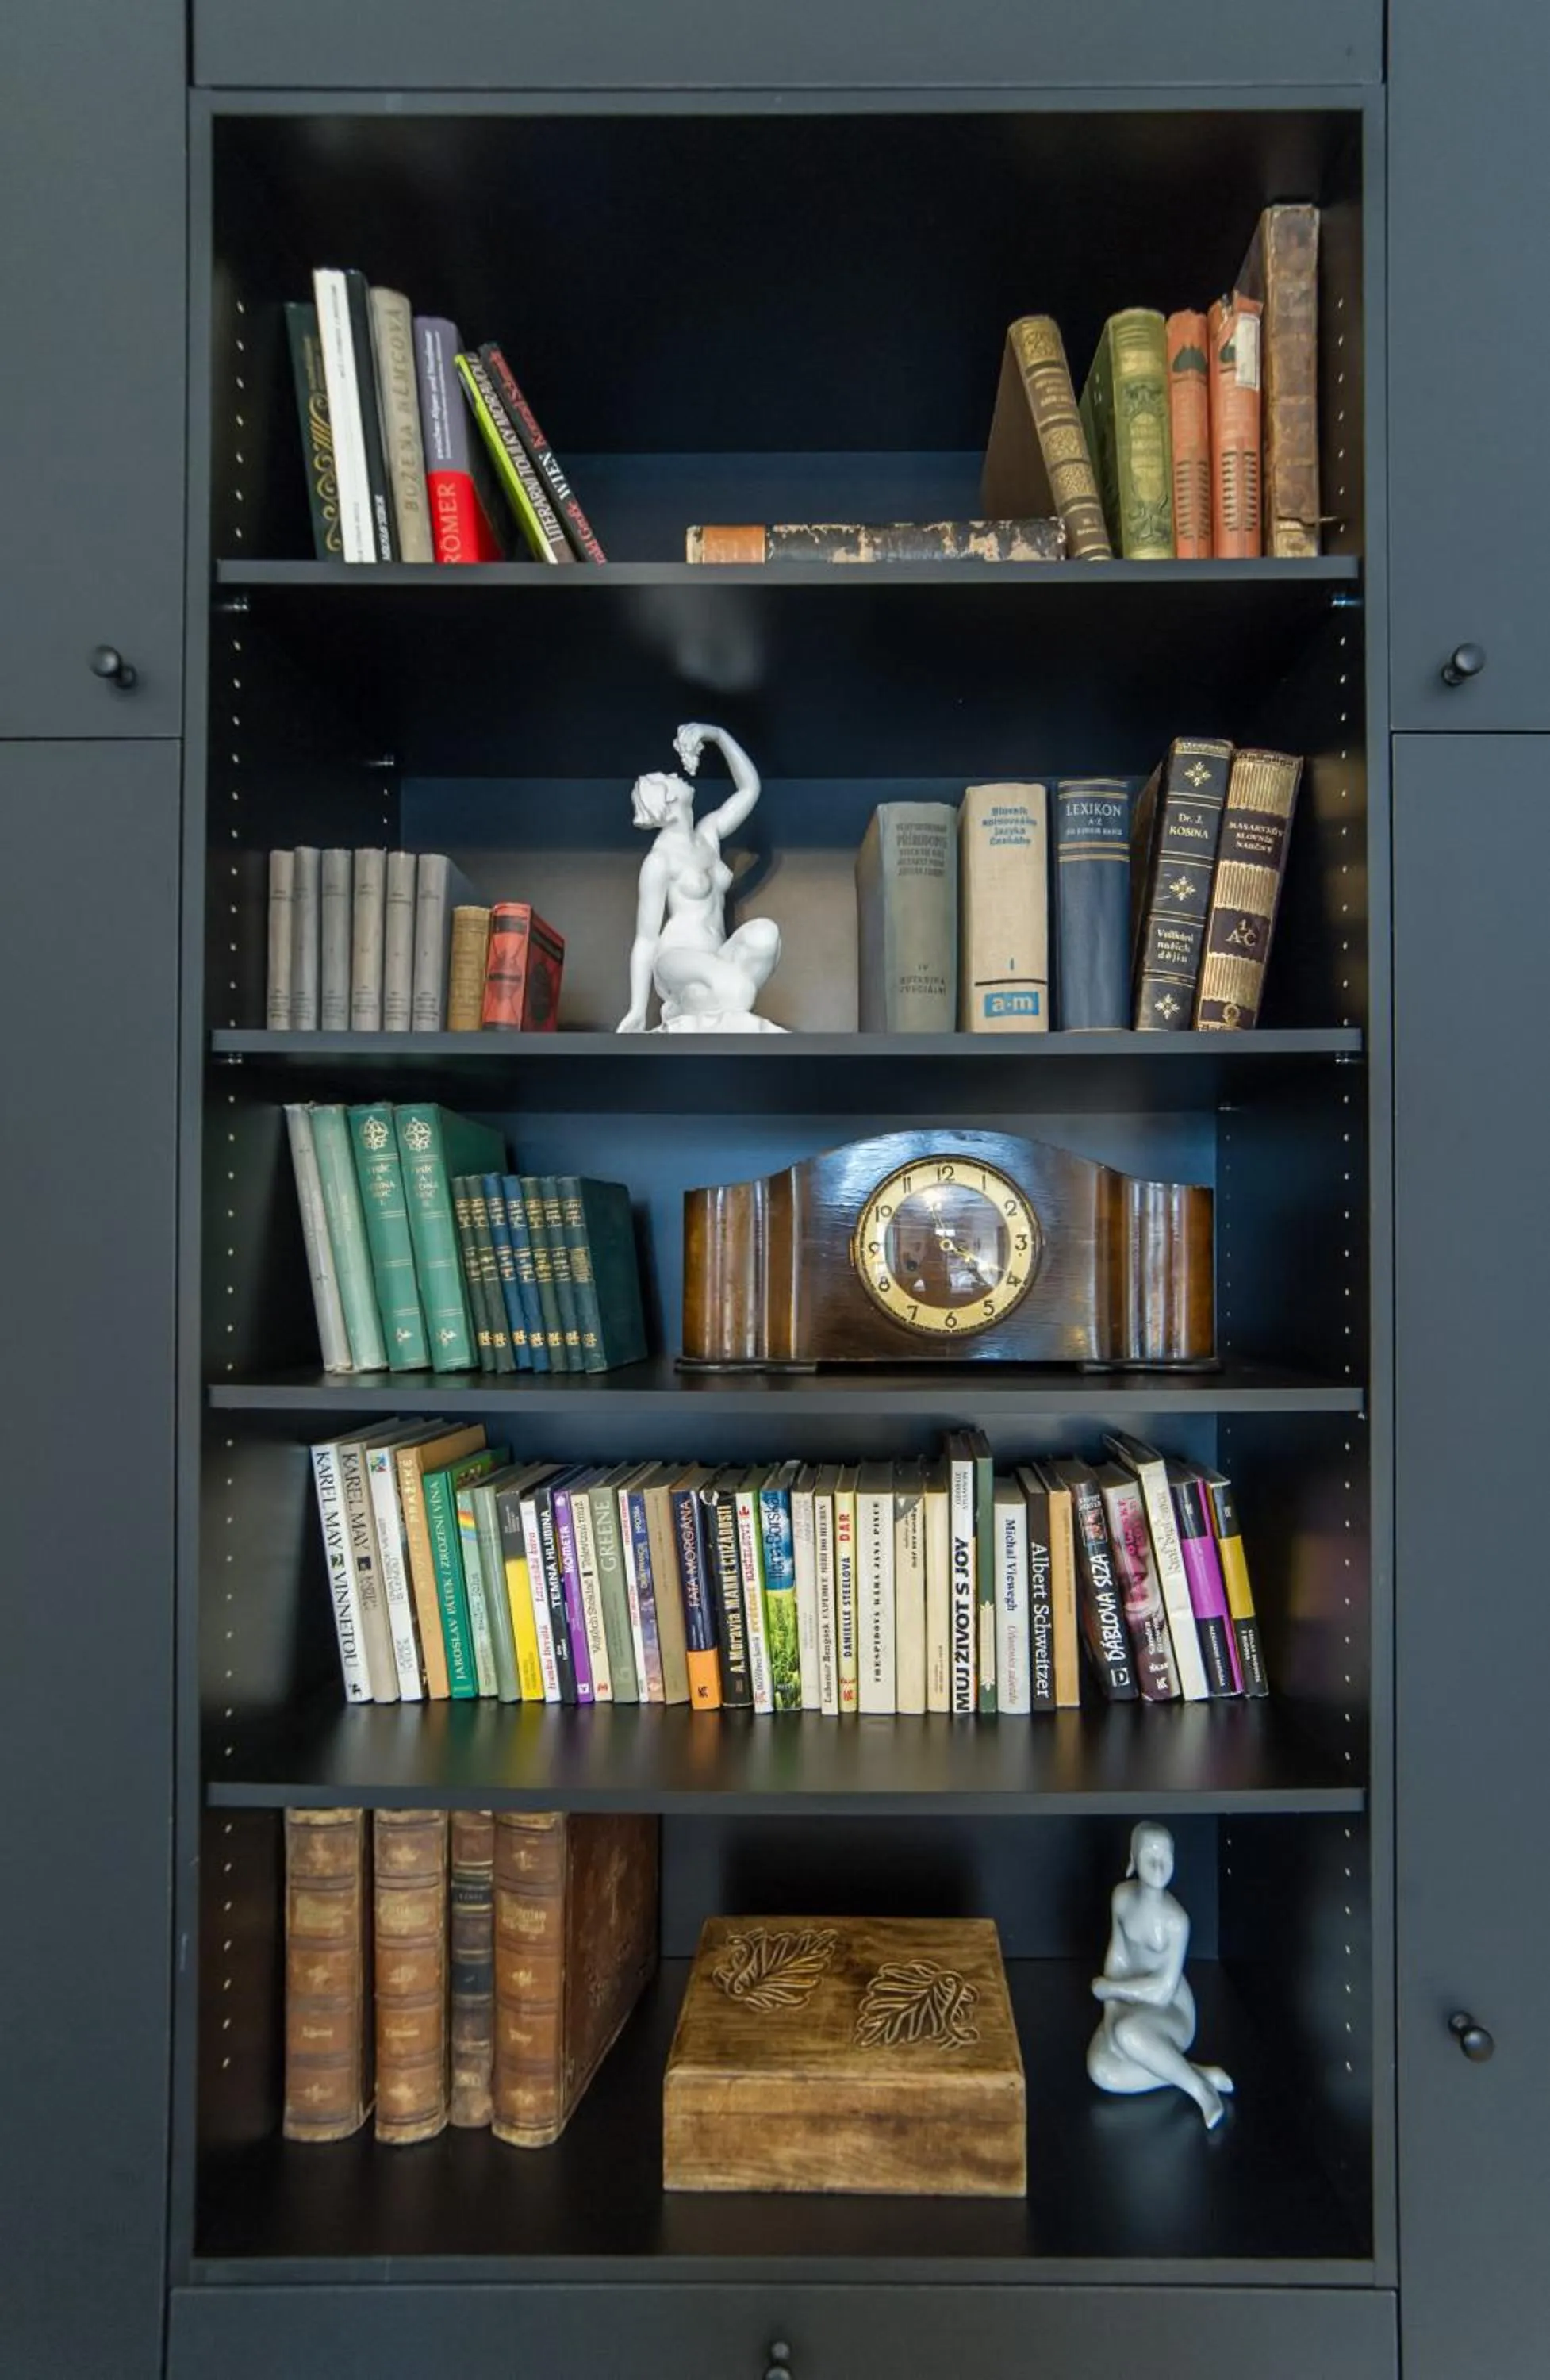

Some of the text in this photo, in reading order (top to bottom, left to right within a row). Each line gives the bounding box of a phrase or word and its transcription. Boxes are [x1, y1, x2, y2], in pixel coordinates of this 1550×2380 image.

[539, 451, 574, 501] WIEN
[436, 482, 461, 564] RÖMER
[1066, 803, 1121, 816] LEXIKON
[1177, 813, 1193, 823] Dr.
[1168, 826, 1210, 839] KOSINA
[903, 1176, 911, 1194] 11
[937, 1165, 955, 1181] 12
[981, 1174, 986, 1191] 1
[875, 1204, 892, 1223] 10
[1003, 1200, 1018, 1216] 2
[868, 1242, 881, 1257] 9
[1015, 1234, 1028, 1251] 3
[878, 1276, 891, 1292] 8
[1006, 1271, 1022, 1287] 4
[906, 1305, 919, 1322] 7
[945, 1311, 957, 1330] 6
[982, 1300, 995, 1317] 5
[343, 1453, 370, 1551] KAREL MAY
[431, 1480, 445, 1511] VÍNA
[435, 1515, 452, 1568] ZROZENÍ
[599, 1499, 618, 1572] GREENE
[681, 1499, 697, 1574] MORGANA
[839, 1514, 850, 1541] DAR
[1006, 1518, 1017, 1558] Michal
[317, 1451, 358, 1668] KAREL MAY VINNETOU
[540, 1509, 562, 1610] TEMNÁ HLUBINA
[558, 1526, 574, 1573] KOMETA
[955, 1537, 969, 1576] JOY
[842, 1557, 850, 1606] STEELOVÁ
[957, 1582, 969, 1594] S
[1005, 1562, 1017, 1611] Viewegh
[1089, 1553, 1114, 1588] SLZA
[443, 1578, 458, 1615] PÁTEK
[727, 1613, 743, 1661] Moravia
[955, 1599, 970, 1662] ŽIVOT
[1031, 1541, 1050, 1698] Albert Schweitzer
[448, 1619, 466, 1680] JAROSLAV
